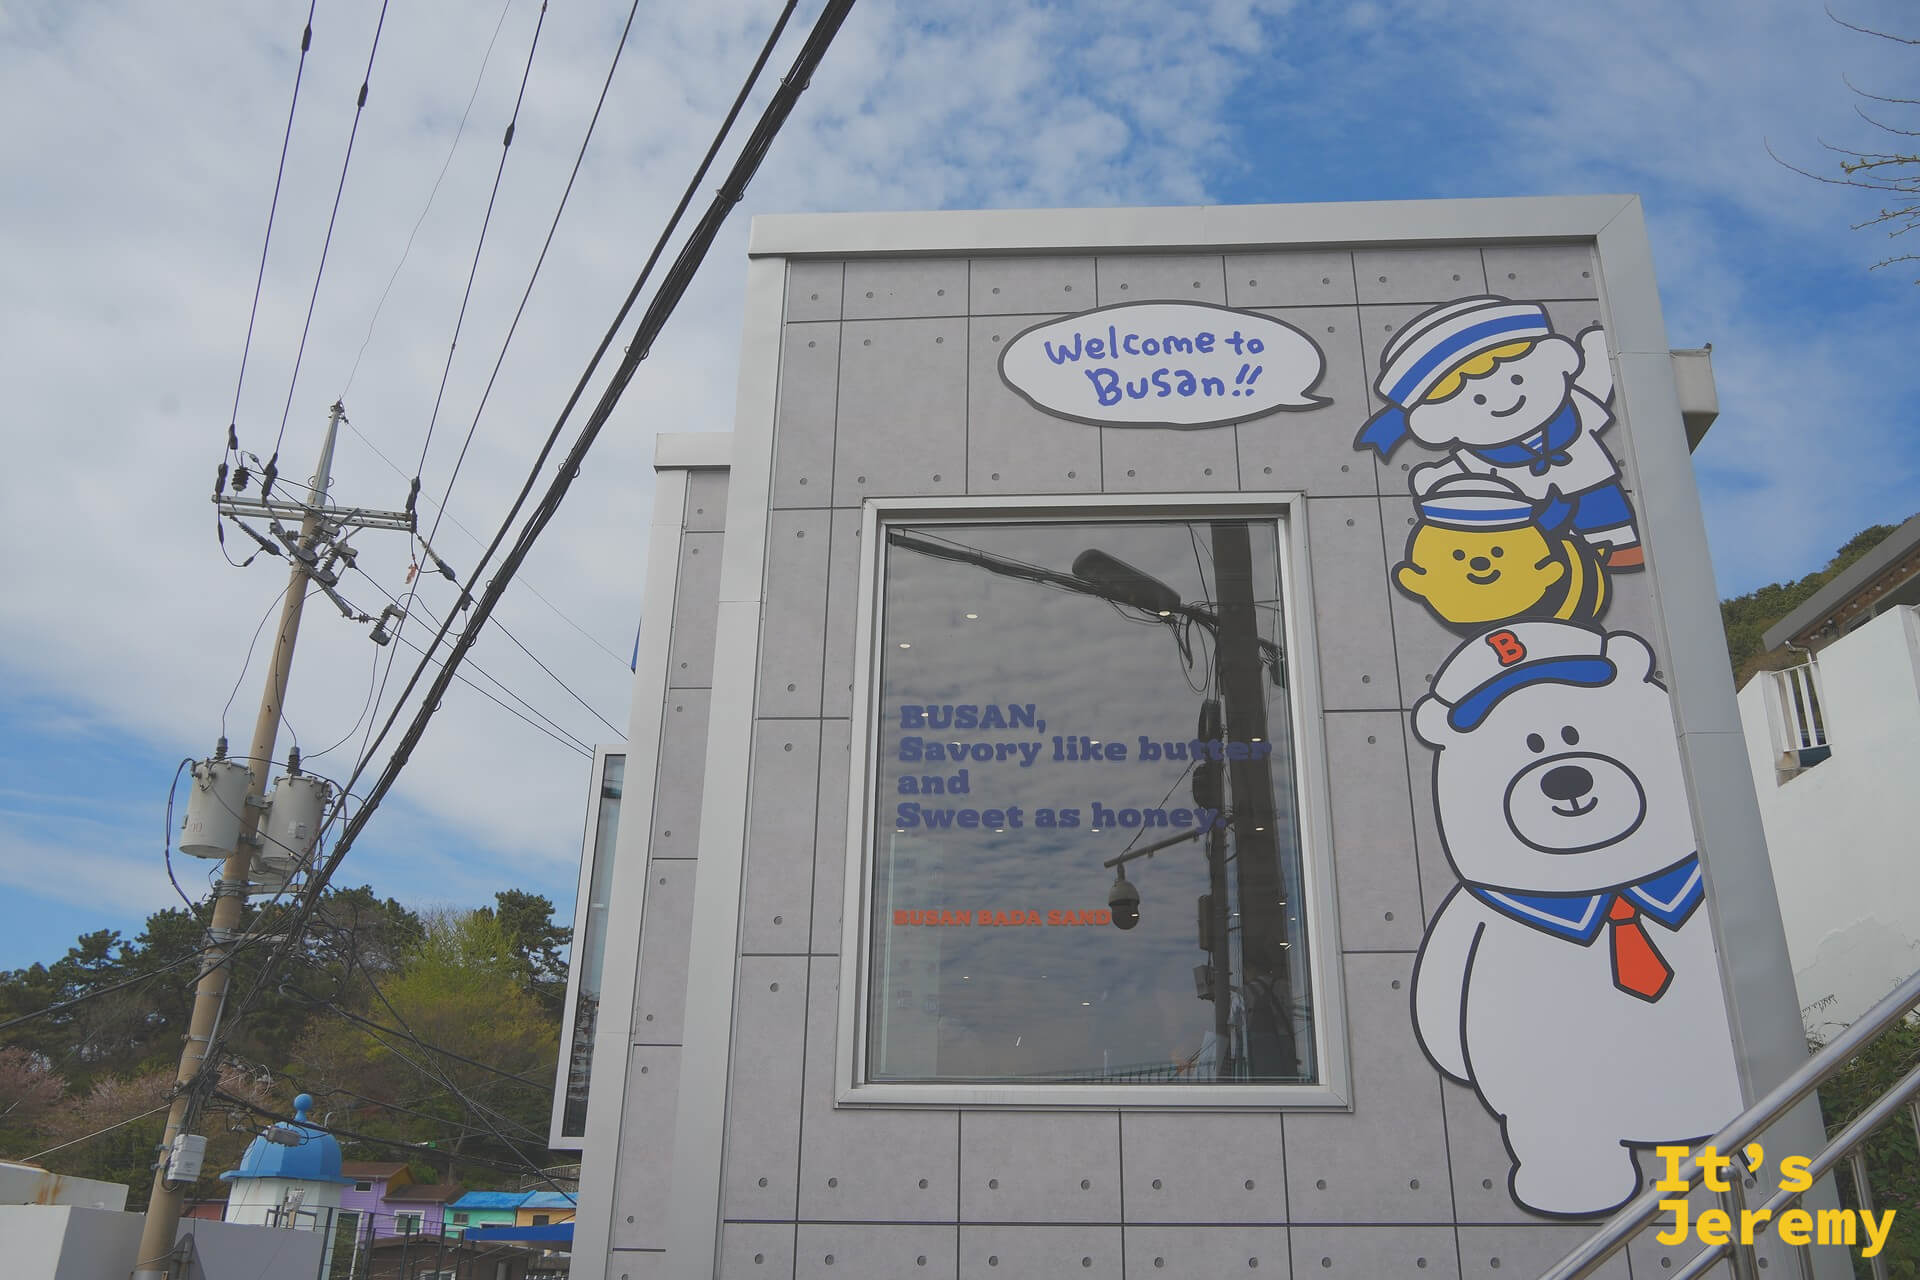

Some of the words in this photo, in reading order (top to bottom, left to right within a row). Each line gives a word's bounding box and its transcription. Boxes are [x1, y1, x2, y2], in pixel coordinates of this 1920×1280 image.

[1045, 326, 1215, 364] Welcome
[1225, 331, 1264, 355] to
[1085, 363, 1262, 406] Busan!!
[1485, 629, 1527, 667] B
[900, 704, 1046, 732] BUSAN,
[898, 736, 1042, 767] Savory
[1052, 736, 1127, 761] like
[1138, 736, 1272, 762] butter
[897, 769, 970, 795] and
[895, 802, 1024, 829] Sweet
[1035, 807, 1080, 828] as
[1091, 802, 1226, 833] honey.
[893, 909, 972, 926] BUSAN
[977, 909, 1044, 926] BADA
[1047, 909, 1111, 926] SAND
